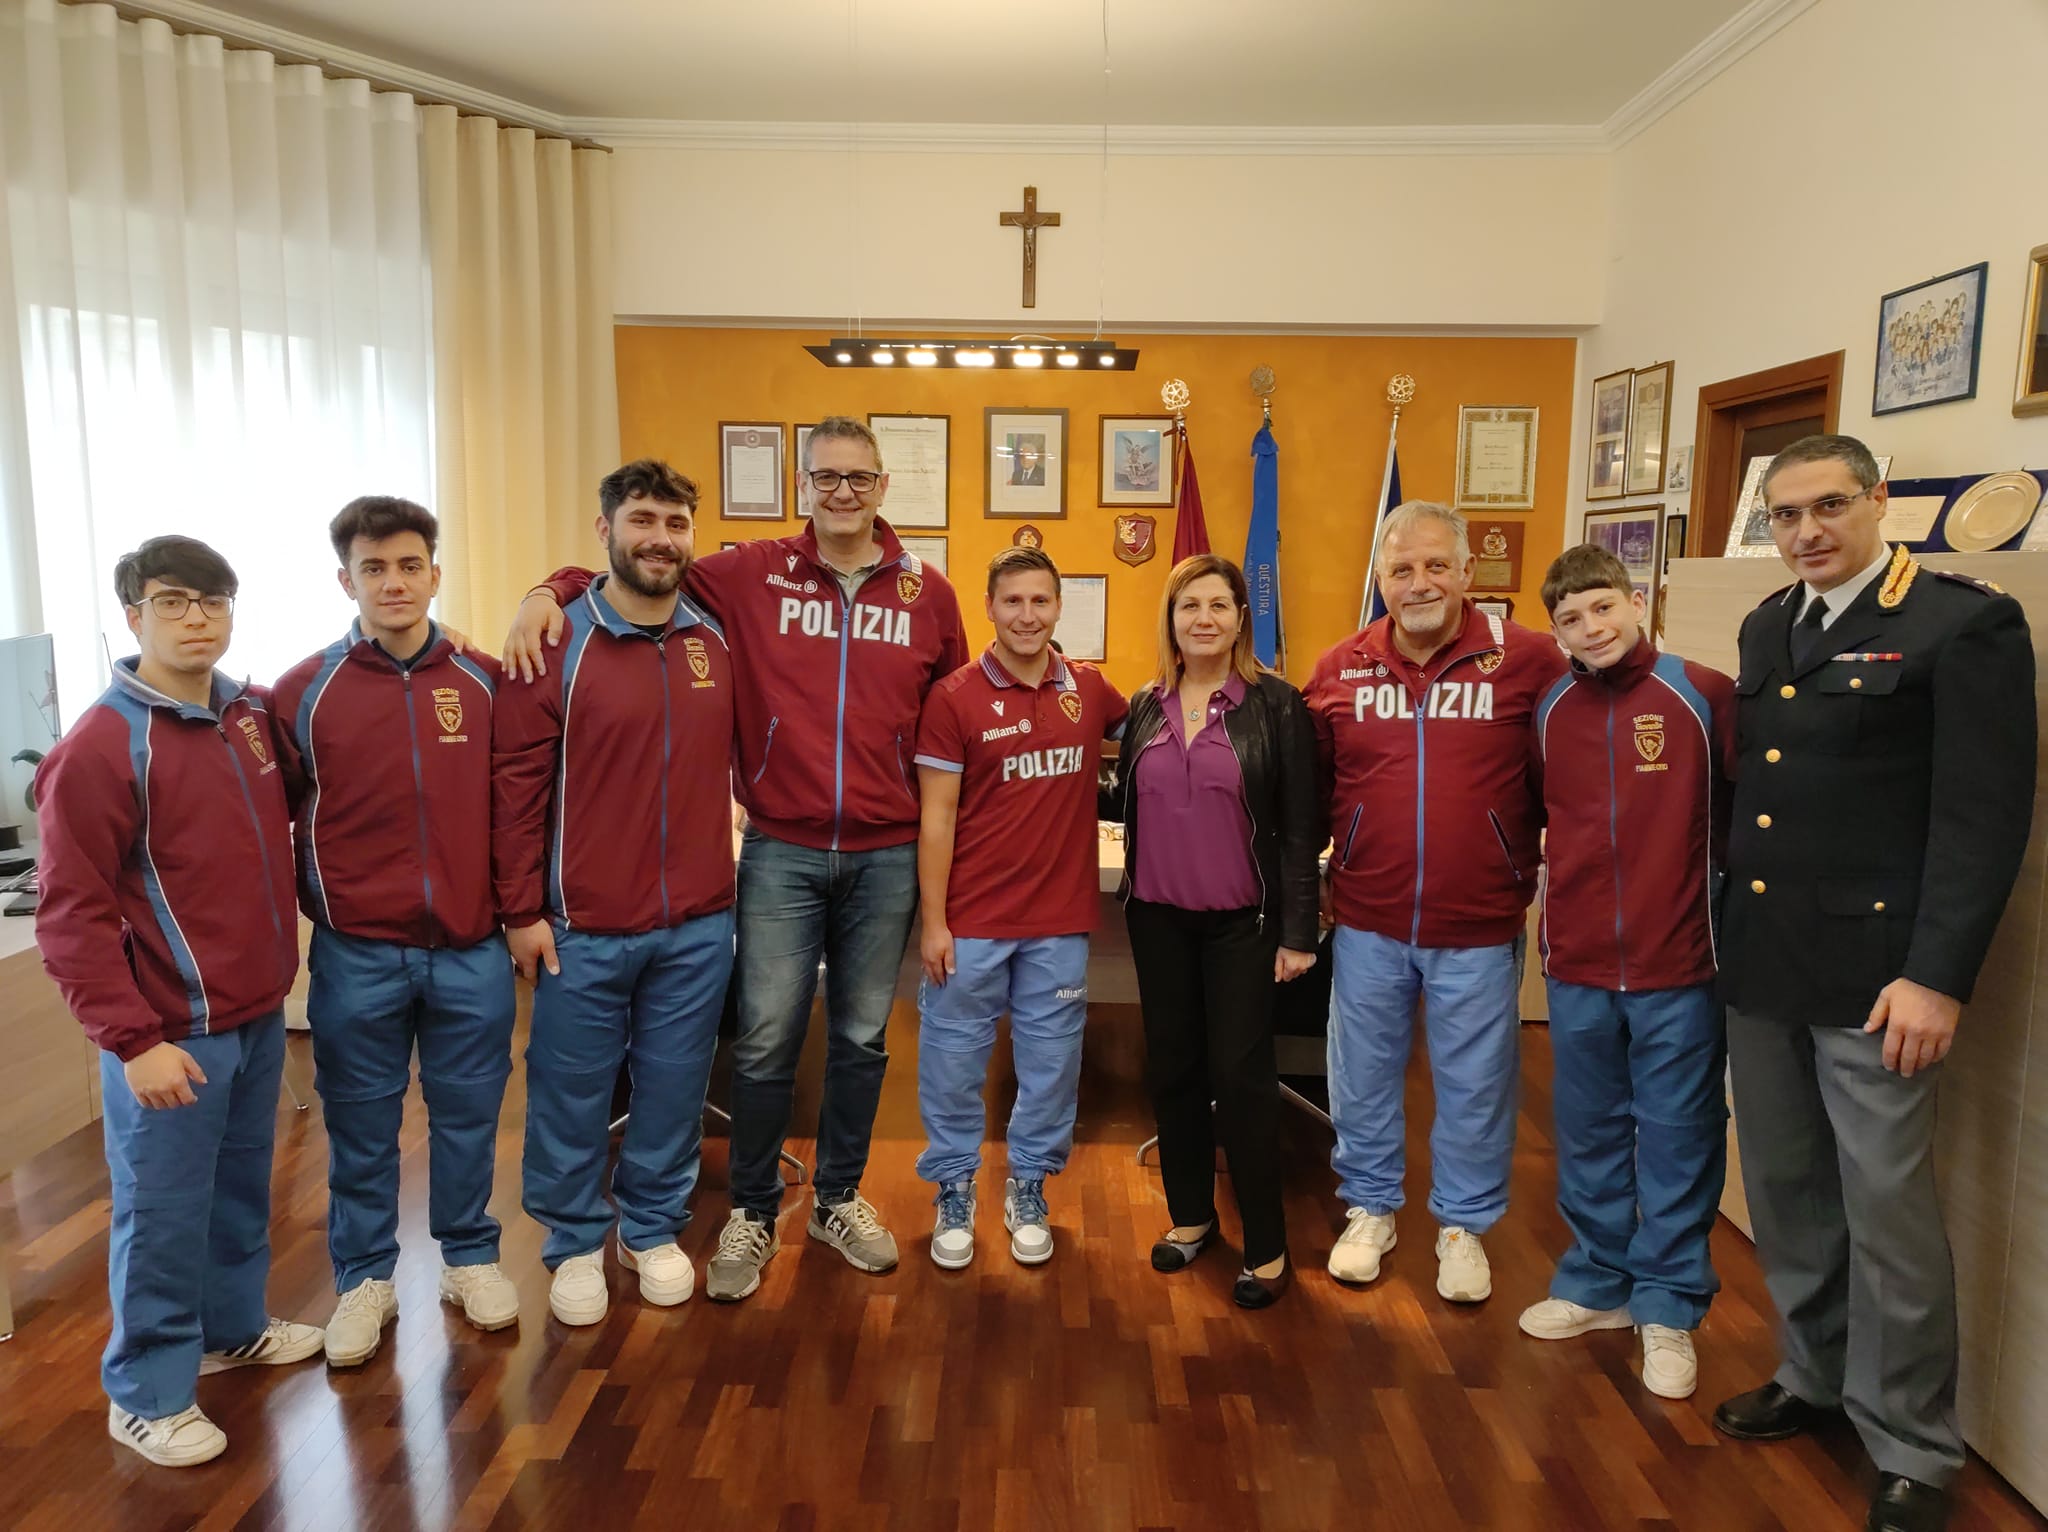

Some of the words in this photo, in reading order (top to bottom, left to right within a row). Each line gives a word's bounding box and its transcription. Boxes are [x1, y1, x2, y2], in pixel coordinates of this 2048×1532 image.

[766, 573, 803, 592] Allianz
[1258, 563, 1270, 617] QUESTURA
[779, 597, 911, 647] POLIZIA
[1339, 667, 1374, 681] Allianz
[1355, 681, 1494, 722] POLIZIA
[982, 725, 1019, 742] Allianz
[1003, 745, 1084, 782] POLIZIA
